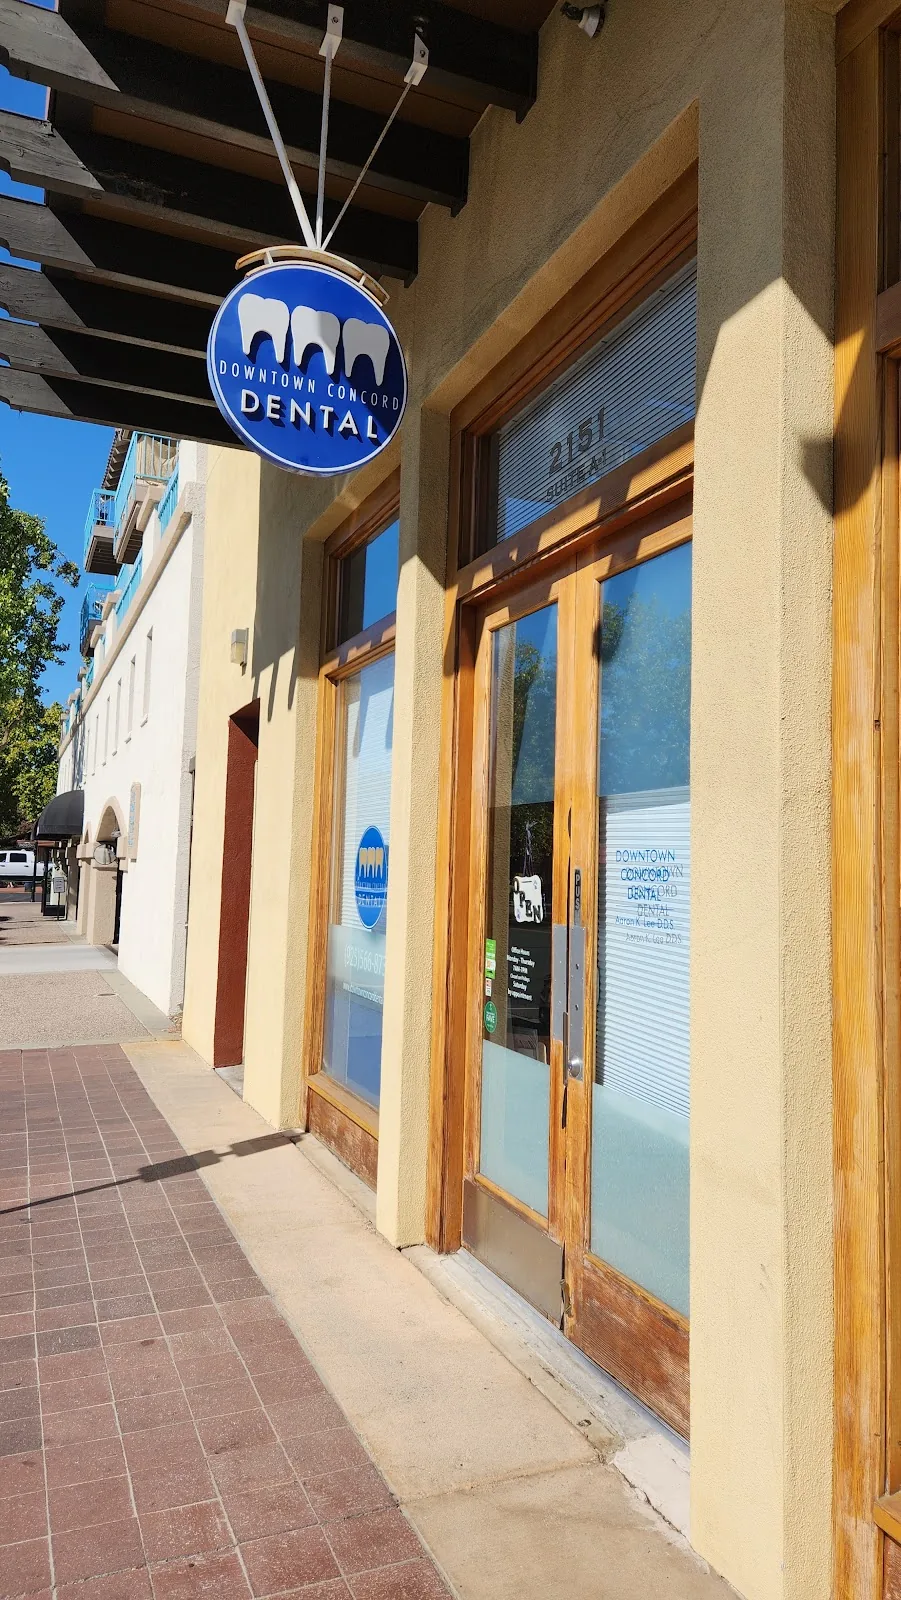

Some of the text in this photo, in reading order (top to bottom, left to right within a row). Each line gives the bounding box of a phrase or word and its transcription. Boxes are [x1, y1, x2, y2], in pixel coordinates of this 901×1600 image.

[219, 359, 399, 411] DOWNTOWN CONCORD
[241, 388, 378, 439] DENTAL
[549, 406, 605, 476] 2151
[546, 462, 586, 502] SUITE
[616, 849, 675, 862] DOWNTOWN
[621, 868, 670, 882] CONCORD
[513, 877, 542, 922] OPEN
[627, 887, 661, 901] DENTAL
